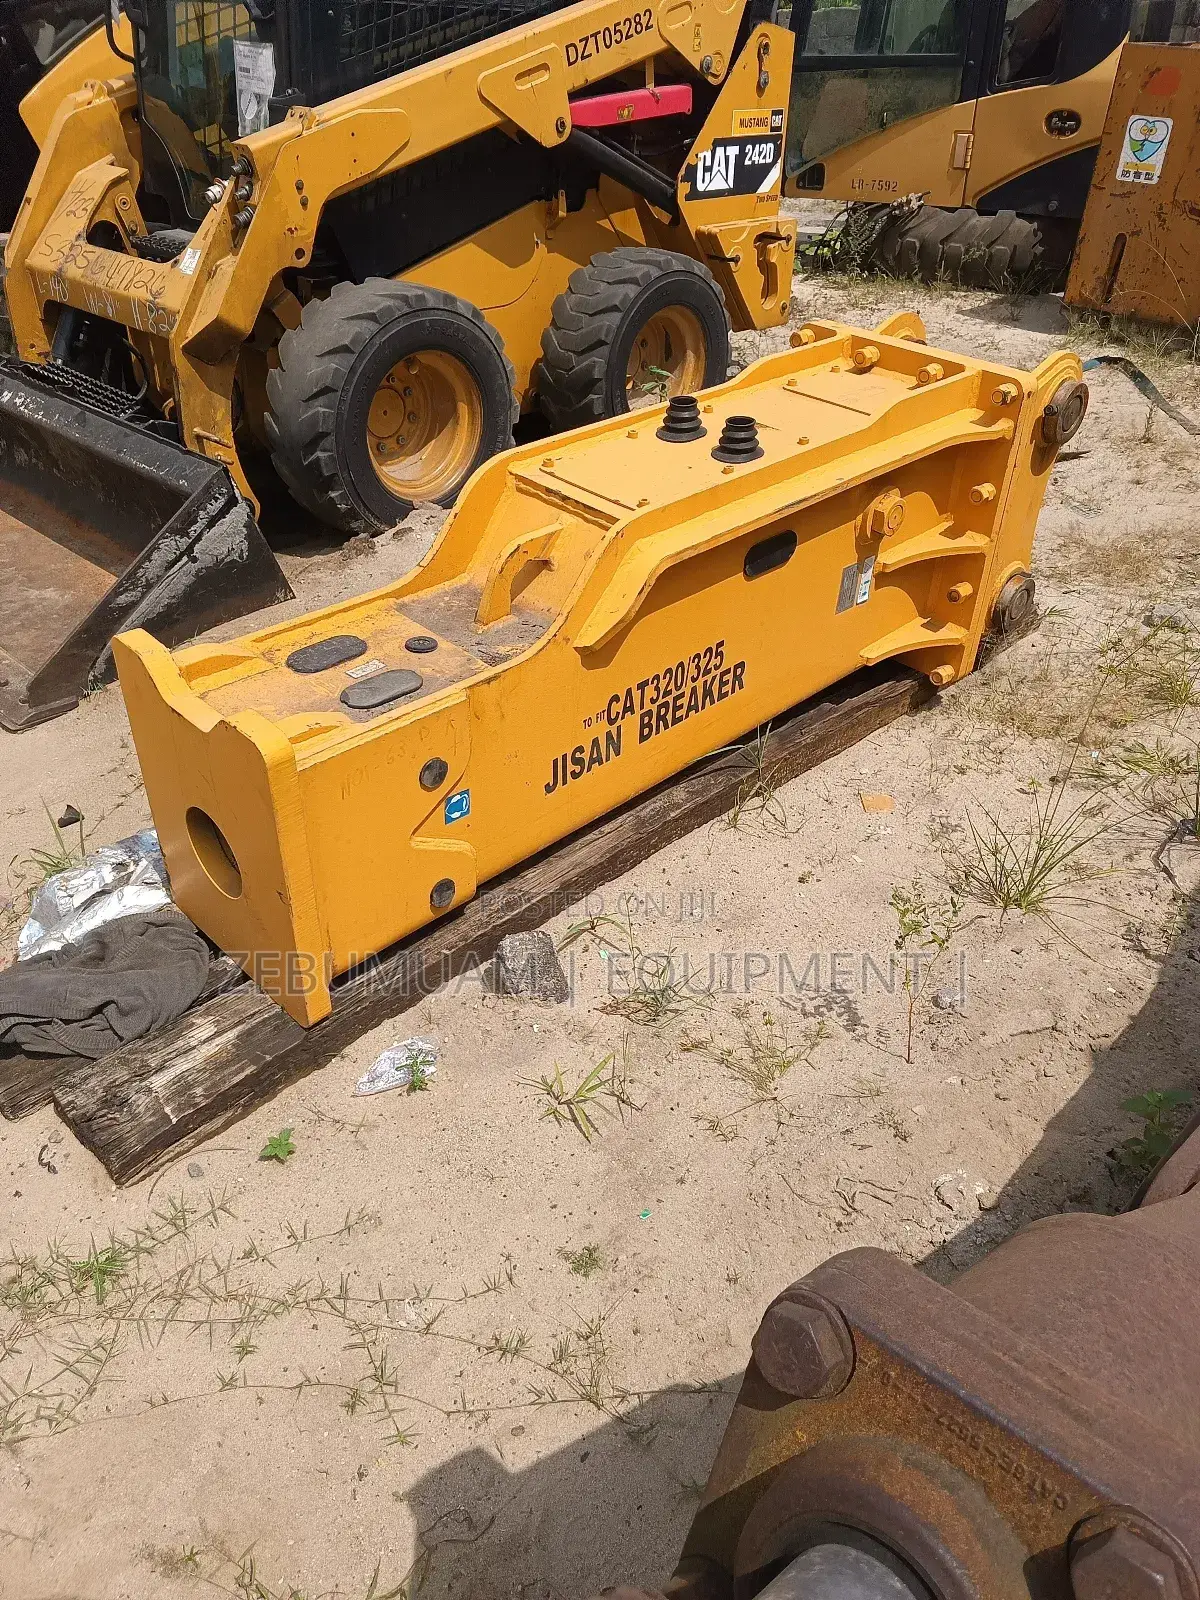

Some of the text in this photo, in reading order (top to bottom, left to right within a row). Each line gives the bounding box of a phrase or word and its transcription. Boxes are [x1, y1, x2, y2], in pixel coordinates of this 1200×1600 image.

[564, 8, 654, 67] DZT05282
[739, 115, 783, 129] MUSTANG CAT
[696, 142, 775, 192] CAT 242D
[851, 178, 898, 192] LR-7592
[583, 640, 726, 730] TO FIT CAT320/325
[544, 725, 622, 795] JISAN
[638, 660, 746, 745] BREAKER
